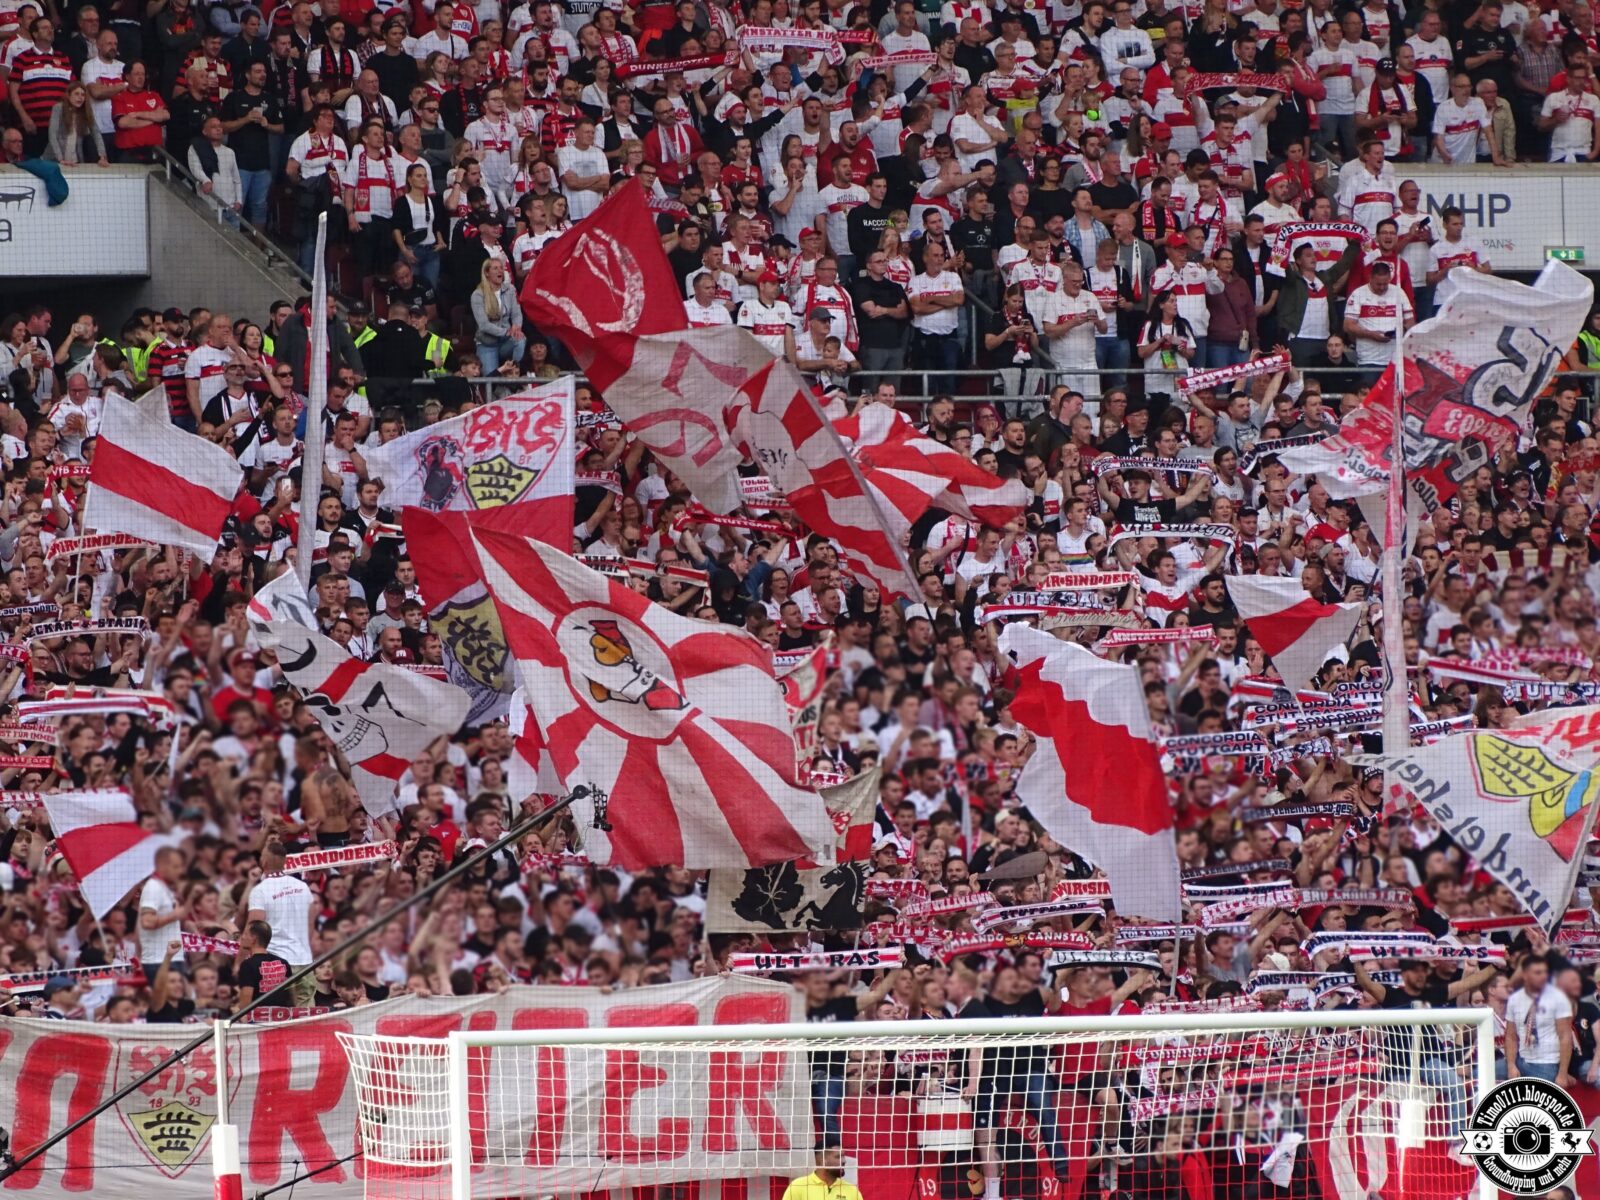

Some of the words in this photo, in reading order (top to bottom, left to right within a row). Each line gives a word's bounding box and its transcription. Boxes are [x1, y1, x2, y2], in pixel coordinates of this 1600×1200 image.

[1427, 193, 1511, 227] MHP
[1295, 223, 1366, 236] STUTTGART
[1120, 524, 1153, 535] VfB
[1157, 524, 1233, 537] Stuttgar
[1065, 575, 1097, 587] SIND
[1165, 733, 1263, 749] CONCORDIA
[301, 847, 340, 866] SIND
[343, 843, 377, 860] DER
[919, 1178, 937, 1197] 19
[1042, 1177, 1060, 1197] 97
